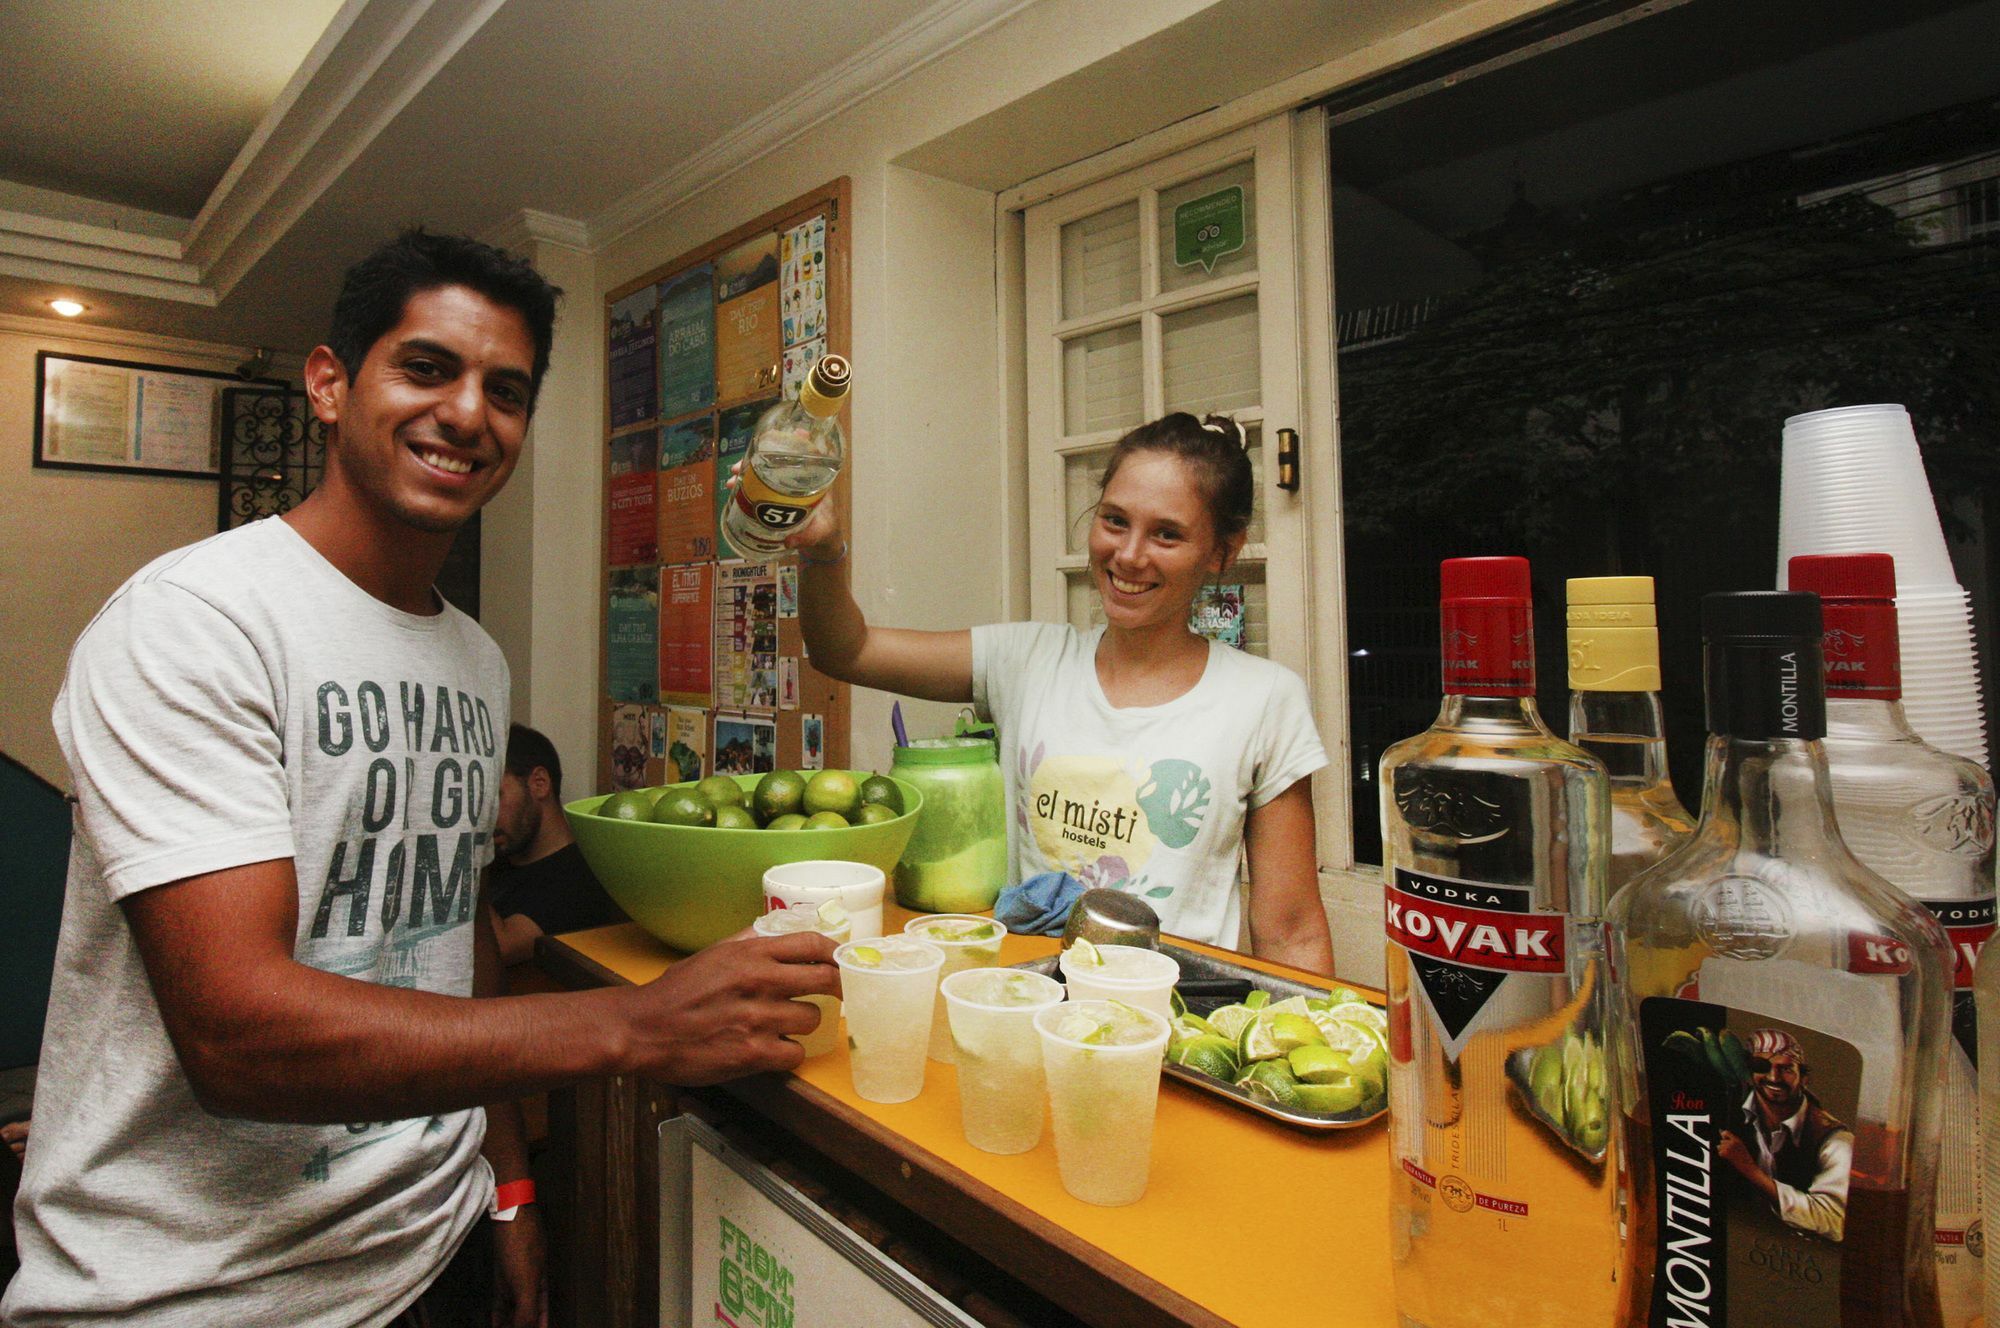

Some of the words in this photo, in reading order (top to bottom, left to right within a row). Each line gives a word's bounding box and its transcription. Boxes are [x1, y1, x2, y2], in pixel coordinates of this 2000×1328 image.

[763, 508, 797, 525] 51
[1570, 639, 1601, 670] 51
[1780, 651, 1799, 733] MONTILLA
[316, 679, 391, 757] GO
[399, 680, 496, 758] HARD
[430, 757, 485, 829] GO
[1036, 789, 1059, 820] el
[1063, 799, 1138, 844] misti
[1061, 827, 1107, 850] hostels
[1410, 880, 1502, 905] VODKA
[1386, 898, 1552, 957] KOVAK
[1670, 1090, 1705, 1111] Ron
[1478, 1196, 1489, 1207] DE
[1492, 1199, 1526, 1214] PUREZA
